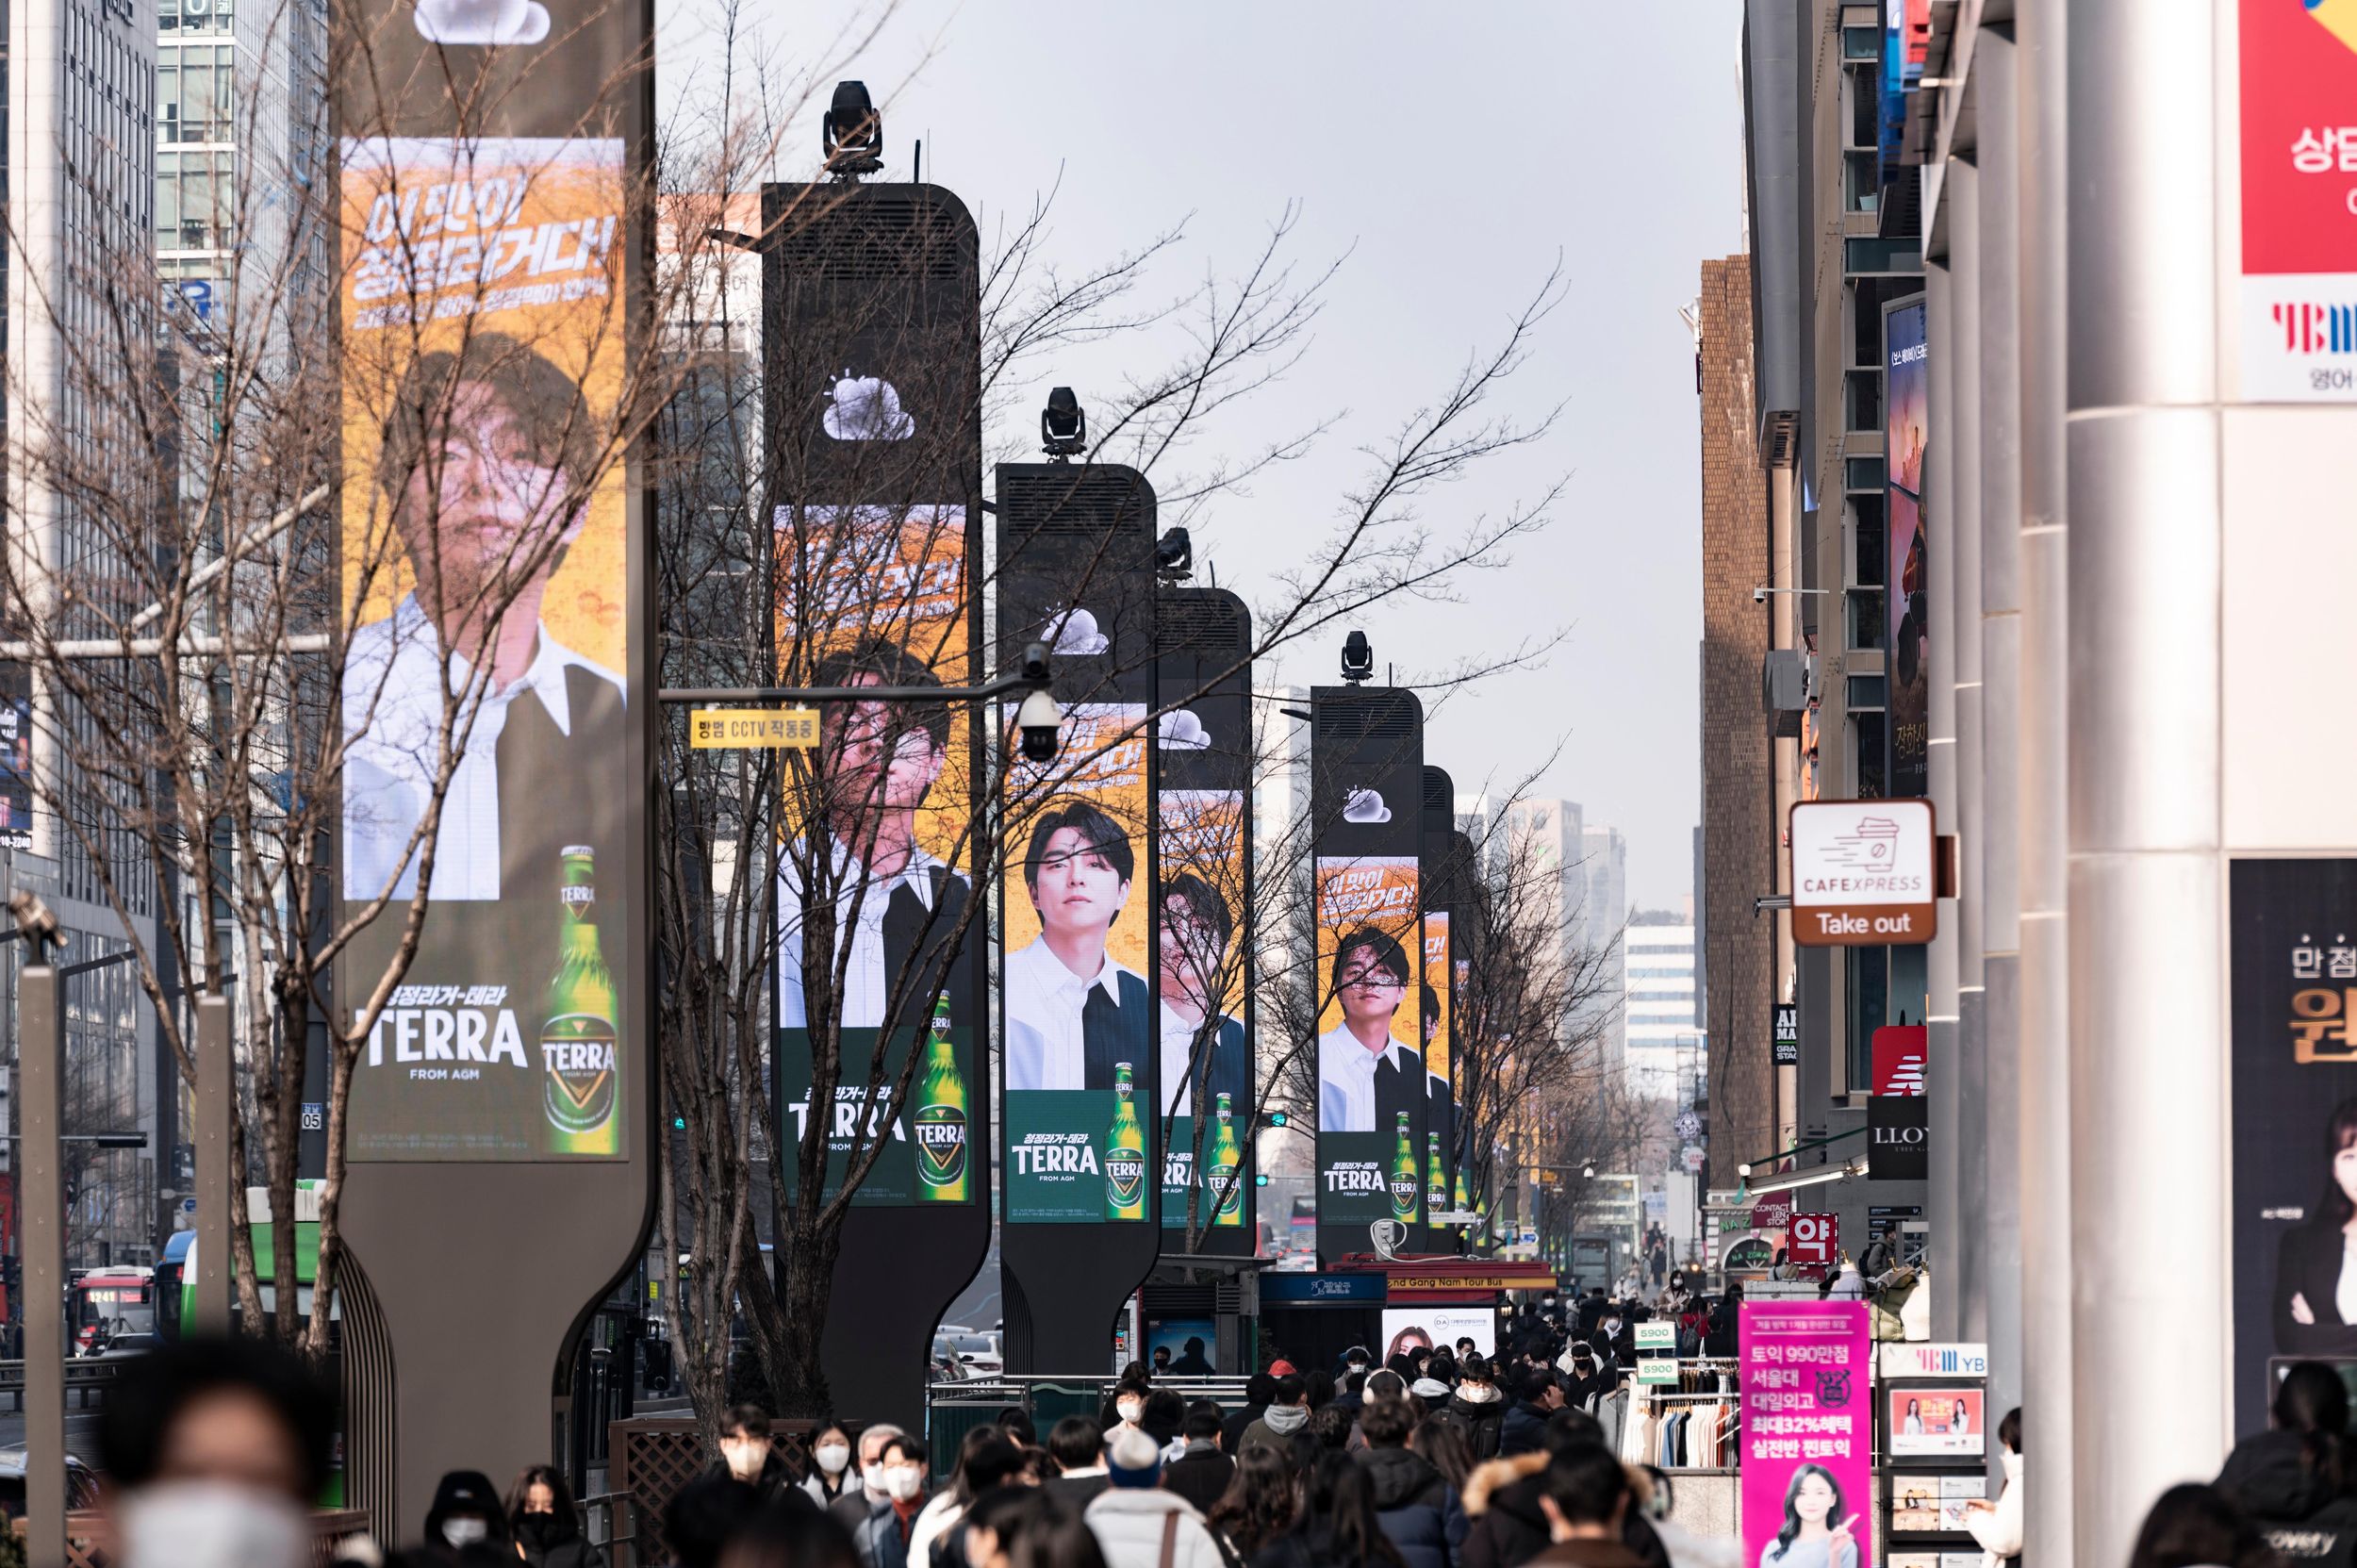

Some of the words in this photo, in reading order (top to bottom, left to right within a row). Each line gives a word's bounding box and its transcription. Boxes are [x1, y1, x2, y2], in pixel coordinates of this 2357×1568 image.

[364, 188, 421, 244] 이
[700, 720, 725, 739] 방범
[731, 720, 766, 738] CCTV
[770, 719, 813, 739] 작동중
[1804, 876, 1921, 892] CAFEXPRESS
[1816, 912, 1870, 934] Take
[1874, 912, 1912, 933] out
[931, 1016, 951, 1031] ERRA
[354, 1008, 529, 1068] TERRA
[541, 1040, 617, 1072] TERRA
[409, 1068, 448, 1081] FROM
[452, 1068, 481, 1081] AGM
[303, 1114, 320, 1128] 05
[788, 1102, 907, 1143] TRRA
[915, 1125, 965, 1145] TERRA
[1024, 1133, 1089, 1145] 청정라거-테라
[1012, 1146, 1099, 1175] TERRA
[1105, 1162, 1143, 1177] TERRA
[1324, 1170, 1387, 1193] TERRA
[1390, 1182, 1417, 1195] TERRA
[1427, 1193, 1446, 1204] ERRA
[1755, 1203, 1789, 1213] CONTACT
[1720, 1220, 1739, 1233] NA
[1794, 1218, 1830, 1261] 약
[1409, 1278, 1436, 1288] Gang
[1439, 1278, 1461, 1287] Nam
[1464, 1278, 1484, 1287] Tour
[1487, 1278, 1503, 1286] Bus
[1640, 1329, 1669, 1338] 5900
[1750, 1345, 1784, 1363] 토익
[1785, 1345, 1850, 1364] 990만점
[1643, 1365, 1673, 1374] 5900
[1751, 1368, 1800, 1388] 서울대
[1751, 1393, 1816, 1411] 대일외고
[1751, 1415, 1853, 1435] 최대32%혜택
[1751, 1439, 1801, 1460] 실전반
[1802, 1439, 1852, 1459] 찐토익
